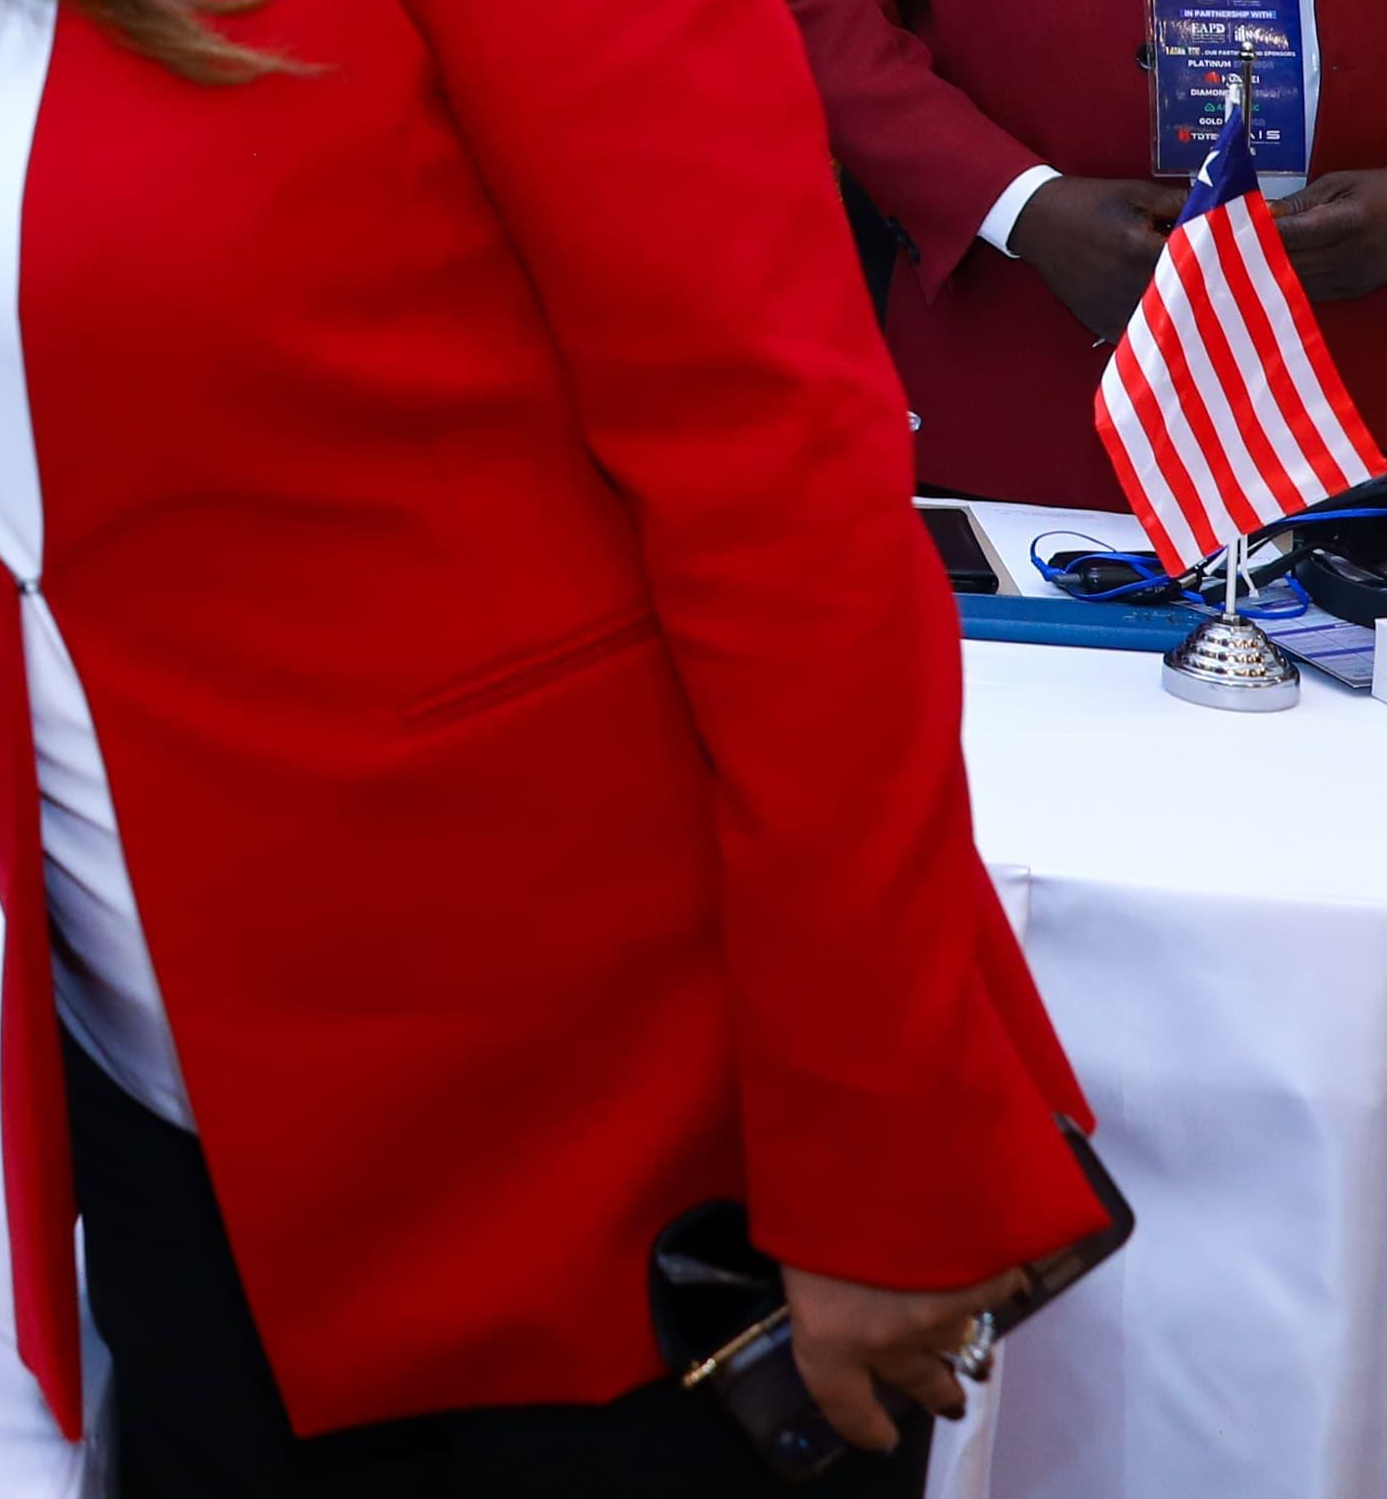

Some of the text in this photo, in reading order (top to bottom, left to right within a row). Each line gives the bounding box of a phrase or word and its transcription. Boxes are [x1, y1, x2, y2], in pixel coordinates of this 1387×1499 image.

[1184, 10, 1273, 19] IN PARTNERSHIP WITH
[1192, 23, 1225, 34] EAPD
[1188, 59, 1231, 68] PLATINUM
[1199, 117, 1223, 125] GOLD
